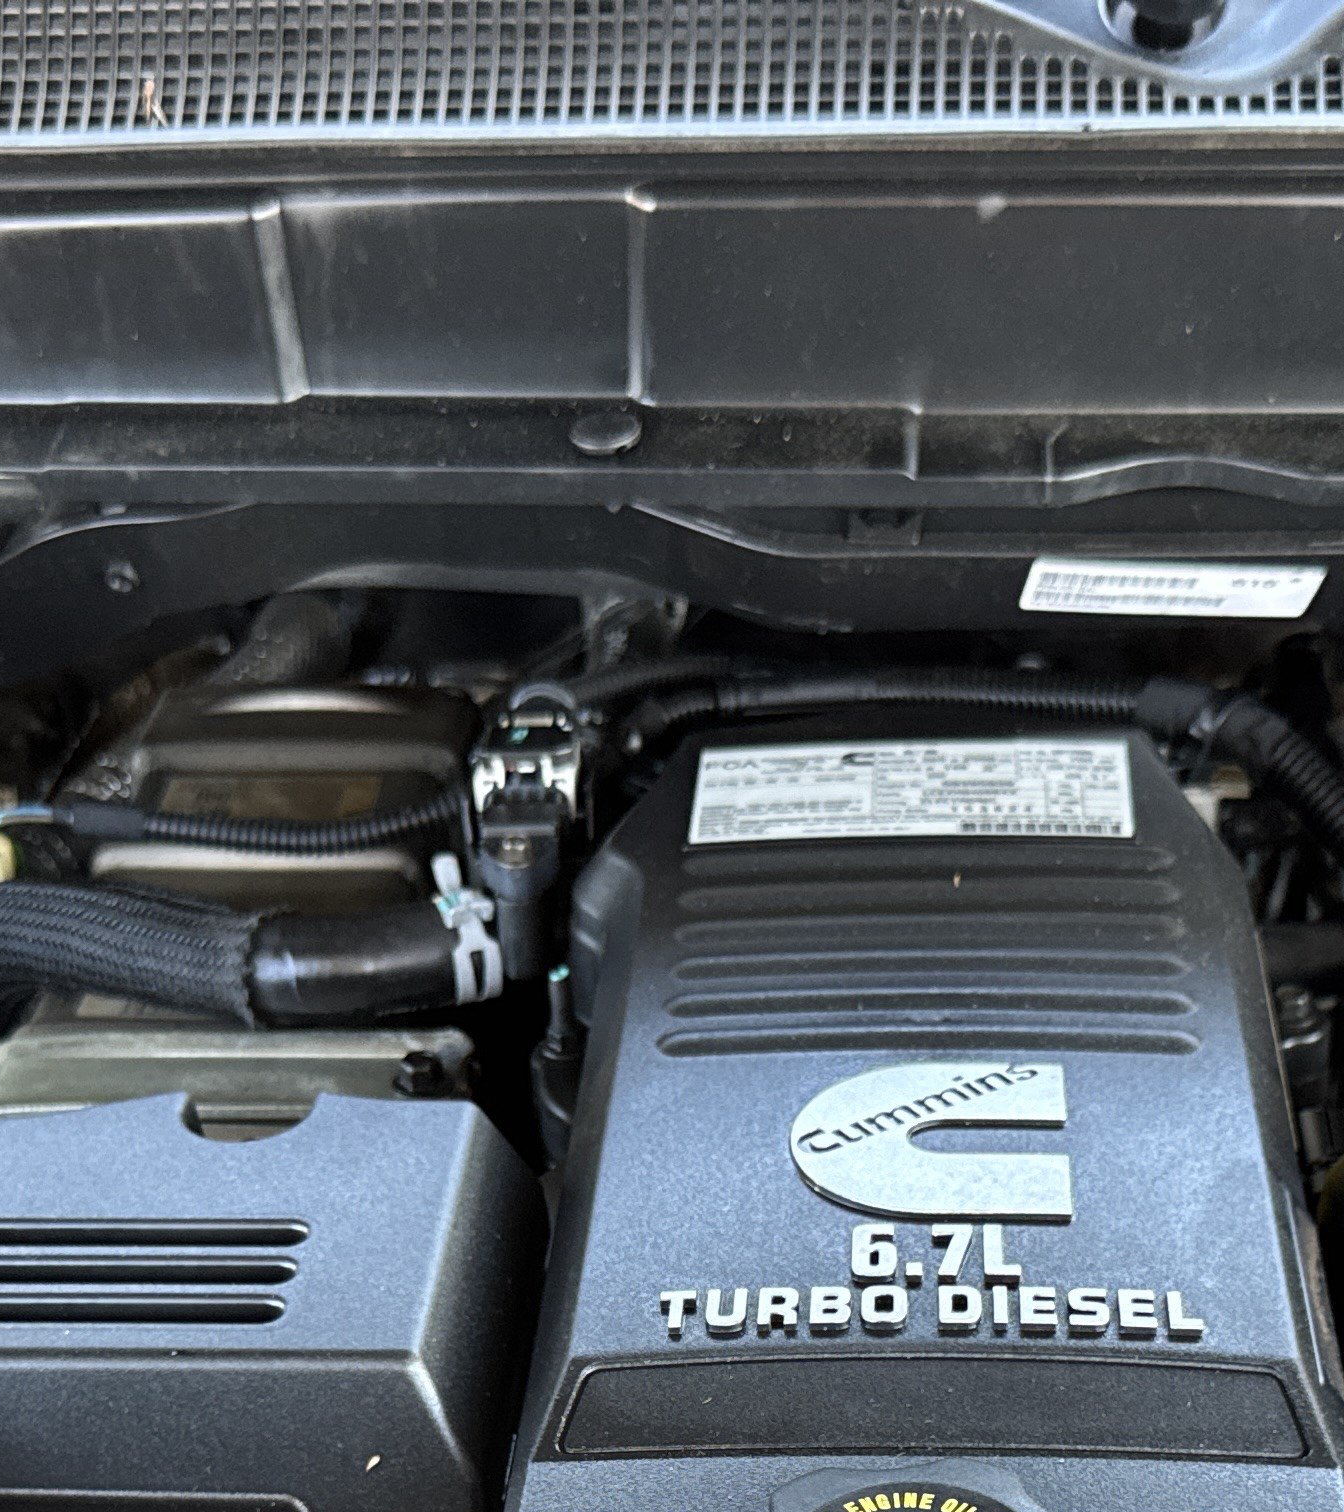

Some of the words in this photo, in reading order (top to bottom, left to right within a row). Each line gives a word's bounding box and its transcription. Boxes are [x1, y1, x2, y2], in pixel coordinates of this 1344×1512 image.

[796, 1059, 1040, 1154] Cummins
[850, 1223, 1022, 1284] 6.7L
[659, 1286, 908, 1336] TURBO
[936, 1286, 1205, 1338] DIESEL
